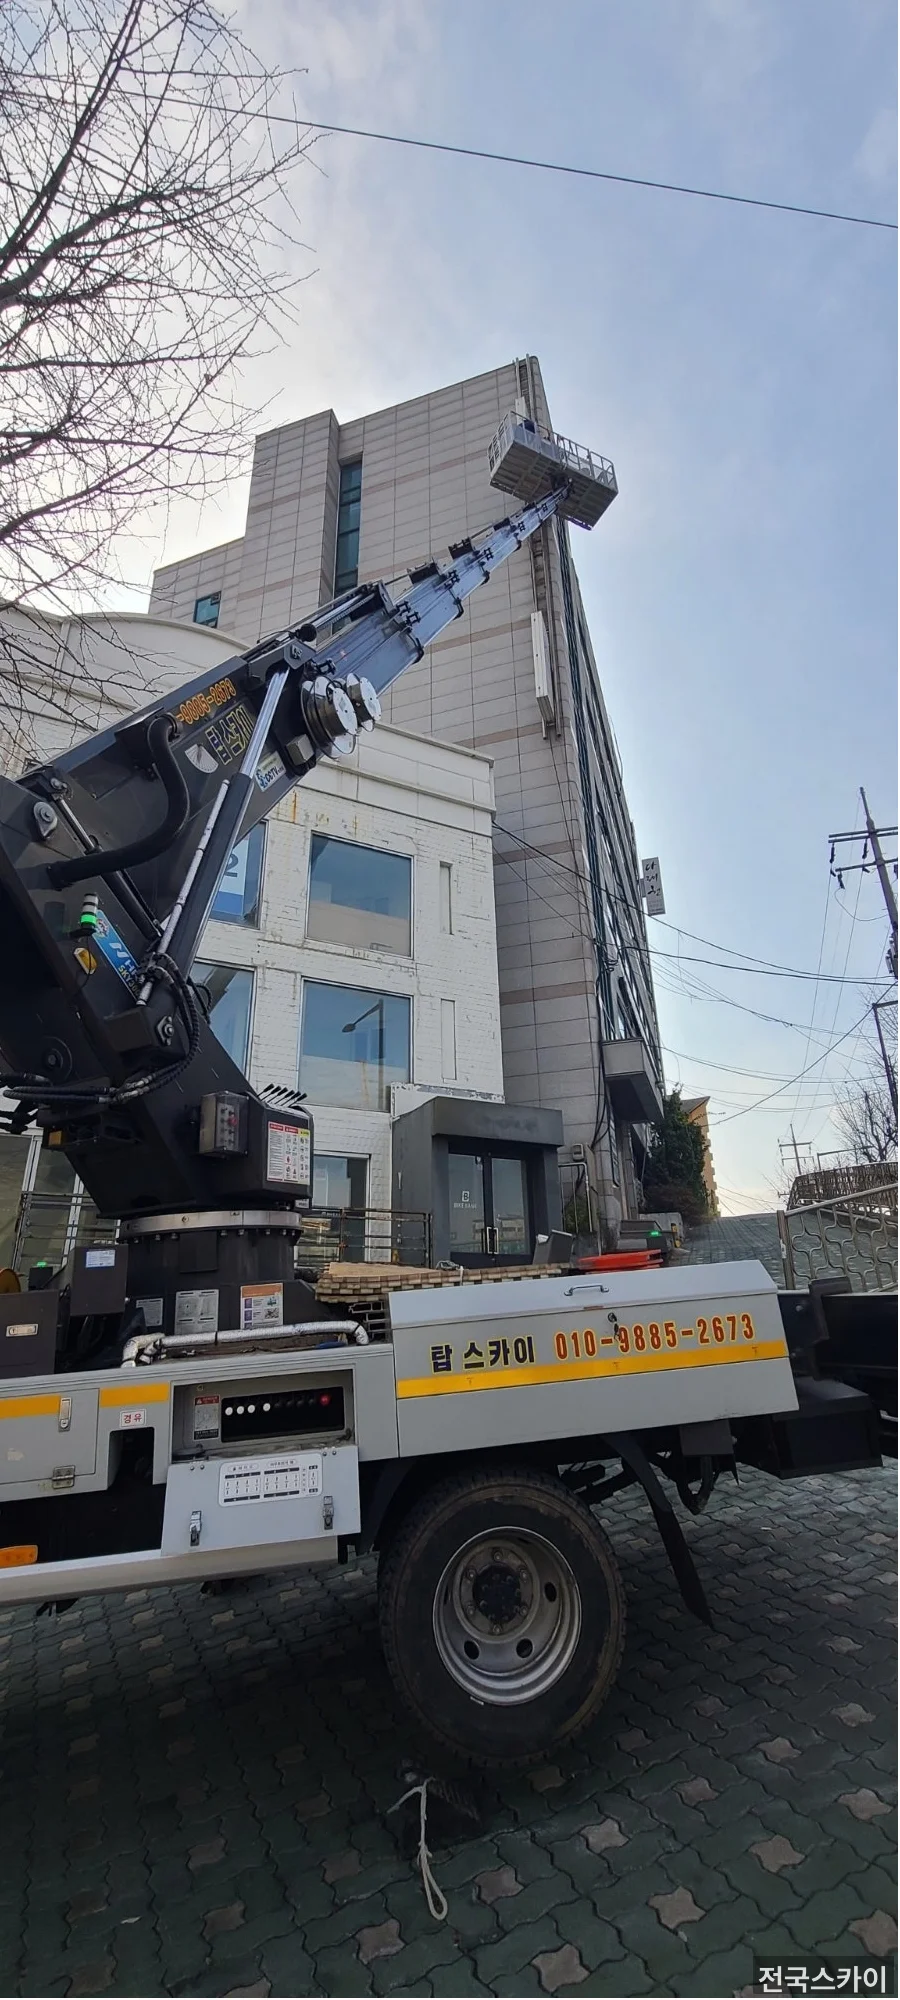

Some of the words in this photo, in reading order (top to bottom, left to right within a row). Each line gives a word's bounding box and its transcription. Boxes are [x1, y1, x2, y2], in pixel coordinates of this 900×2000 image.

[430, 1343, 453, 1374] 탑
[463, 1335, 535, 1370] 스카이
[554, 1313, 755, 1360] 010-9885-2673
[123, 1413, 142, 1424] 경유
